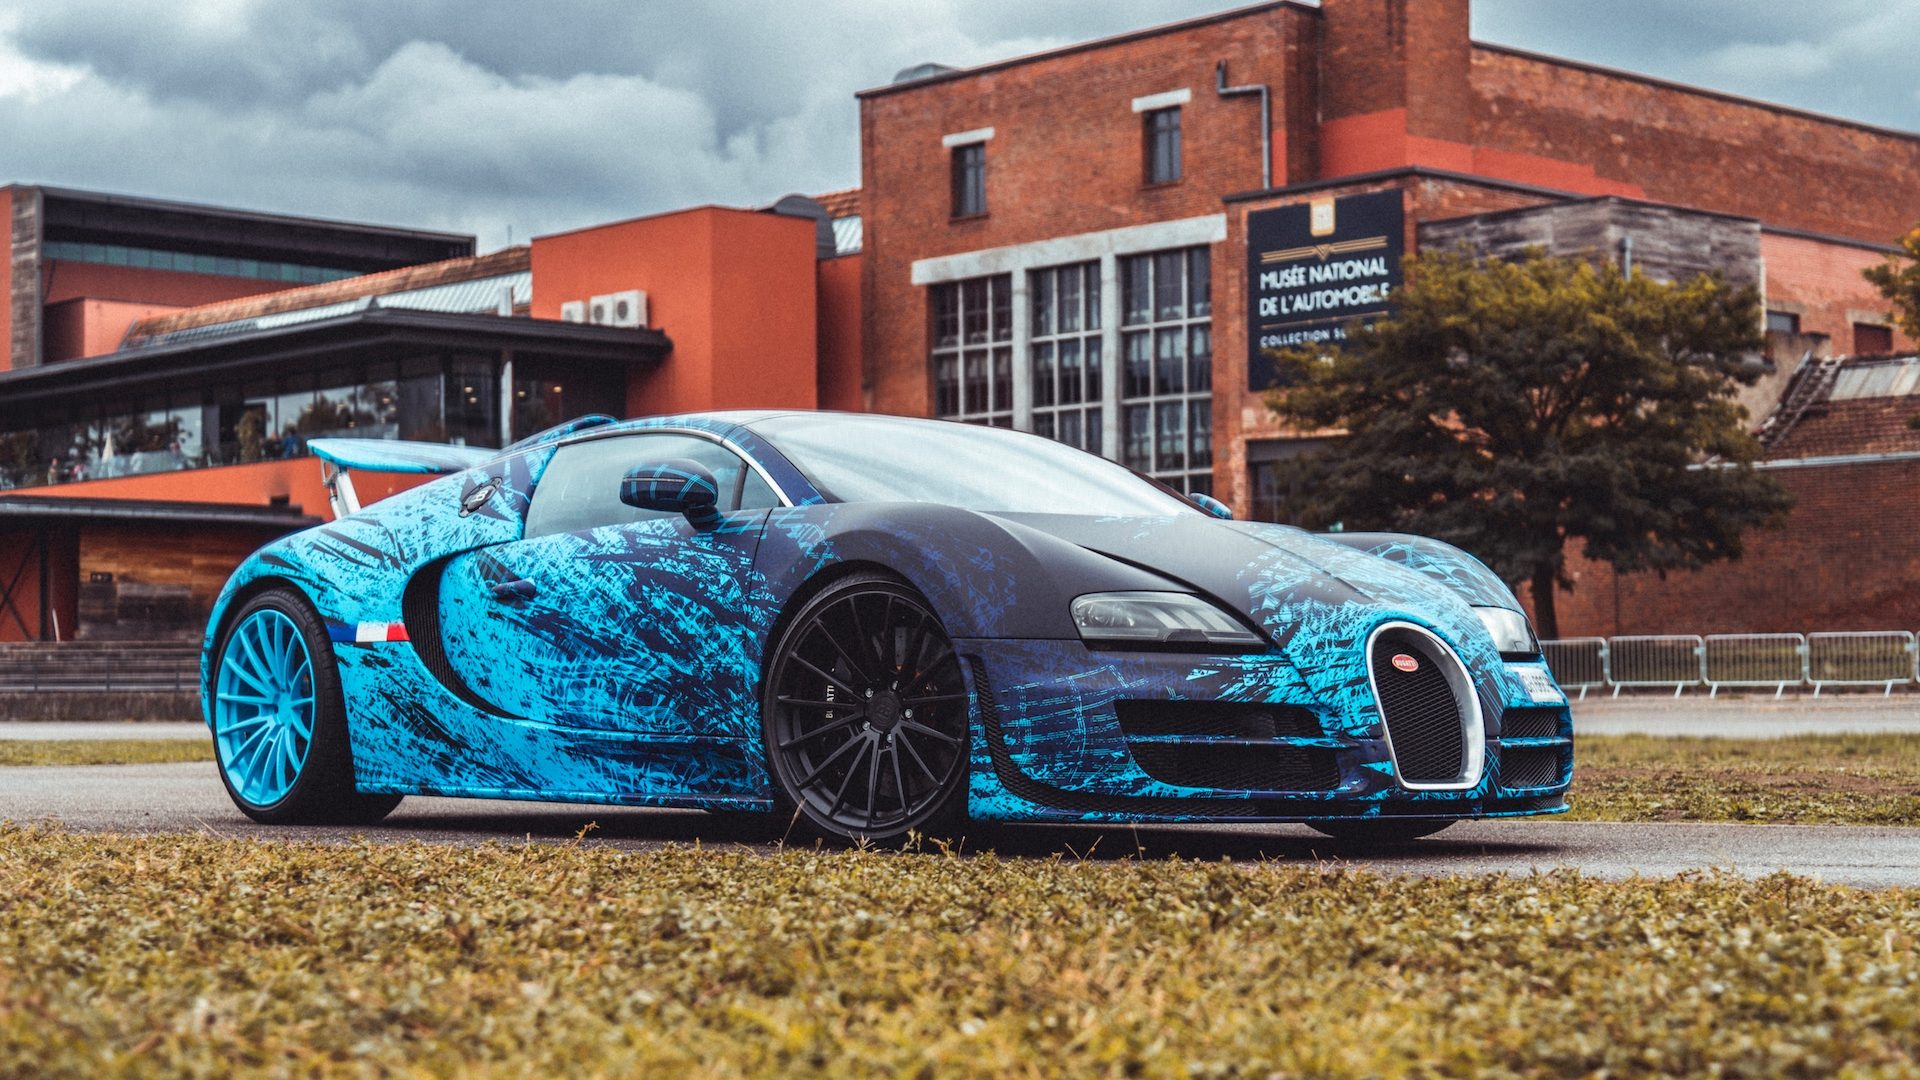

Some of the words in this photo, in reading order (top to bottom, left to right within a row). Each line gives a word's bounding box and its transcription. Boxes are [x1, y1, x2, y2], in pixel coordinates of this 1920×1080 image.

[1260, 264, 1306, 290] MUSÉE
[1309, 256, 1388, 284] NATIONAL
[1260, 297, 1278, 317] DE
[1281, 282, 1390, 315] L'AUTOMOBILE
[1260, 330, 1330, 349] COLLECTION
[825, 685, 834, 718] BUATTI
